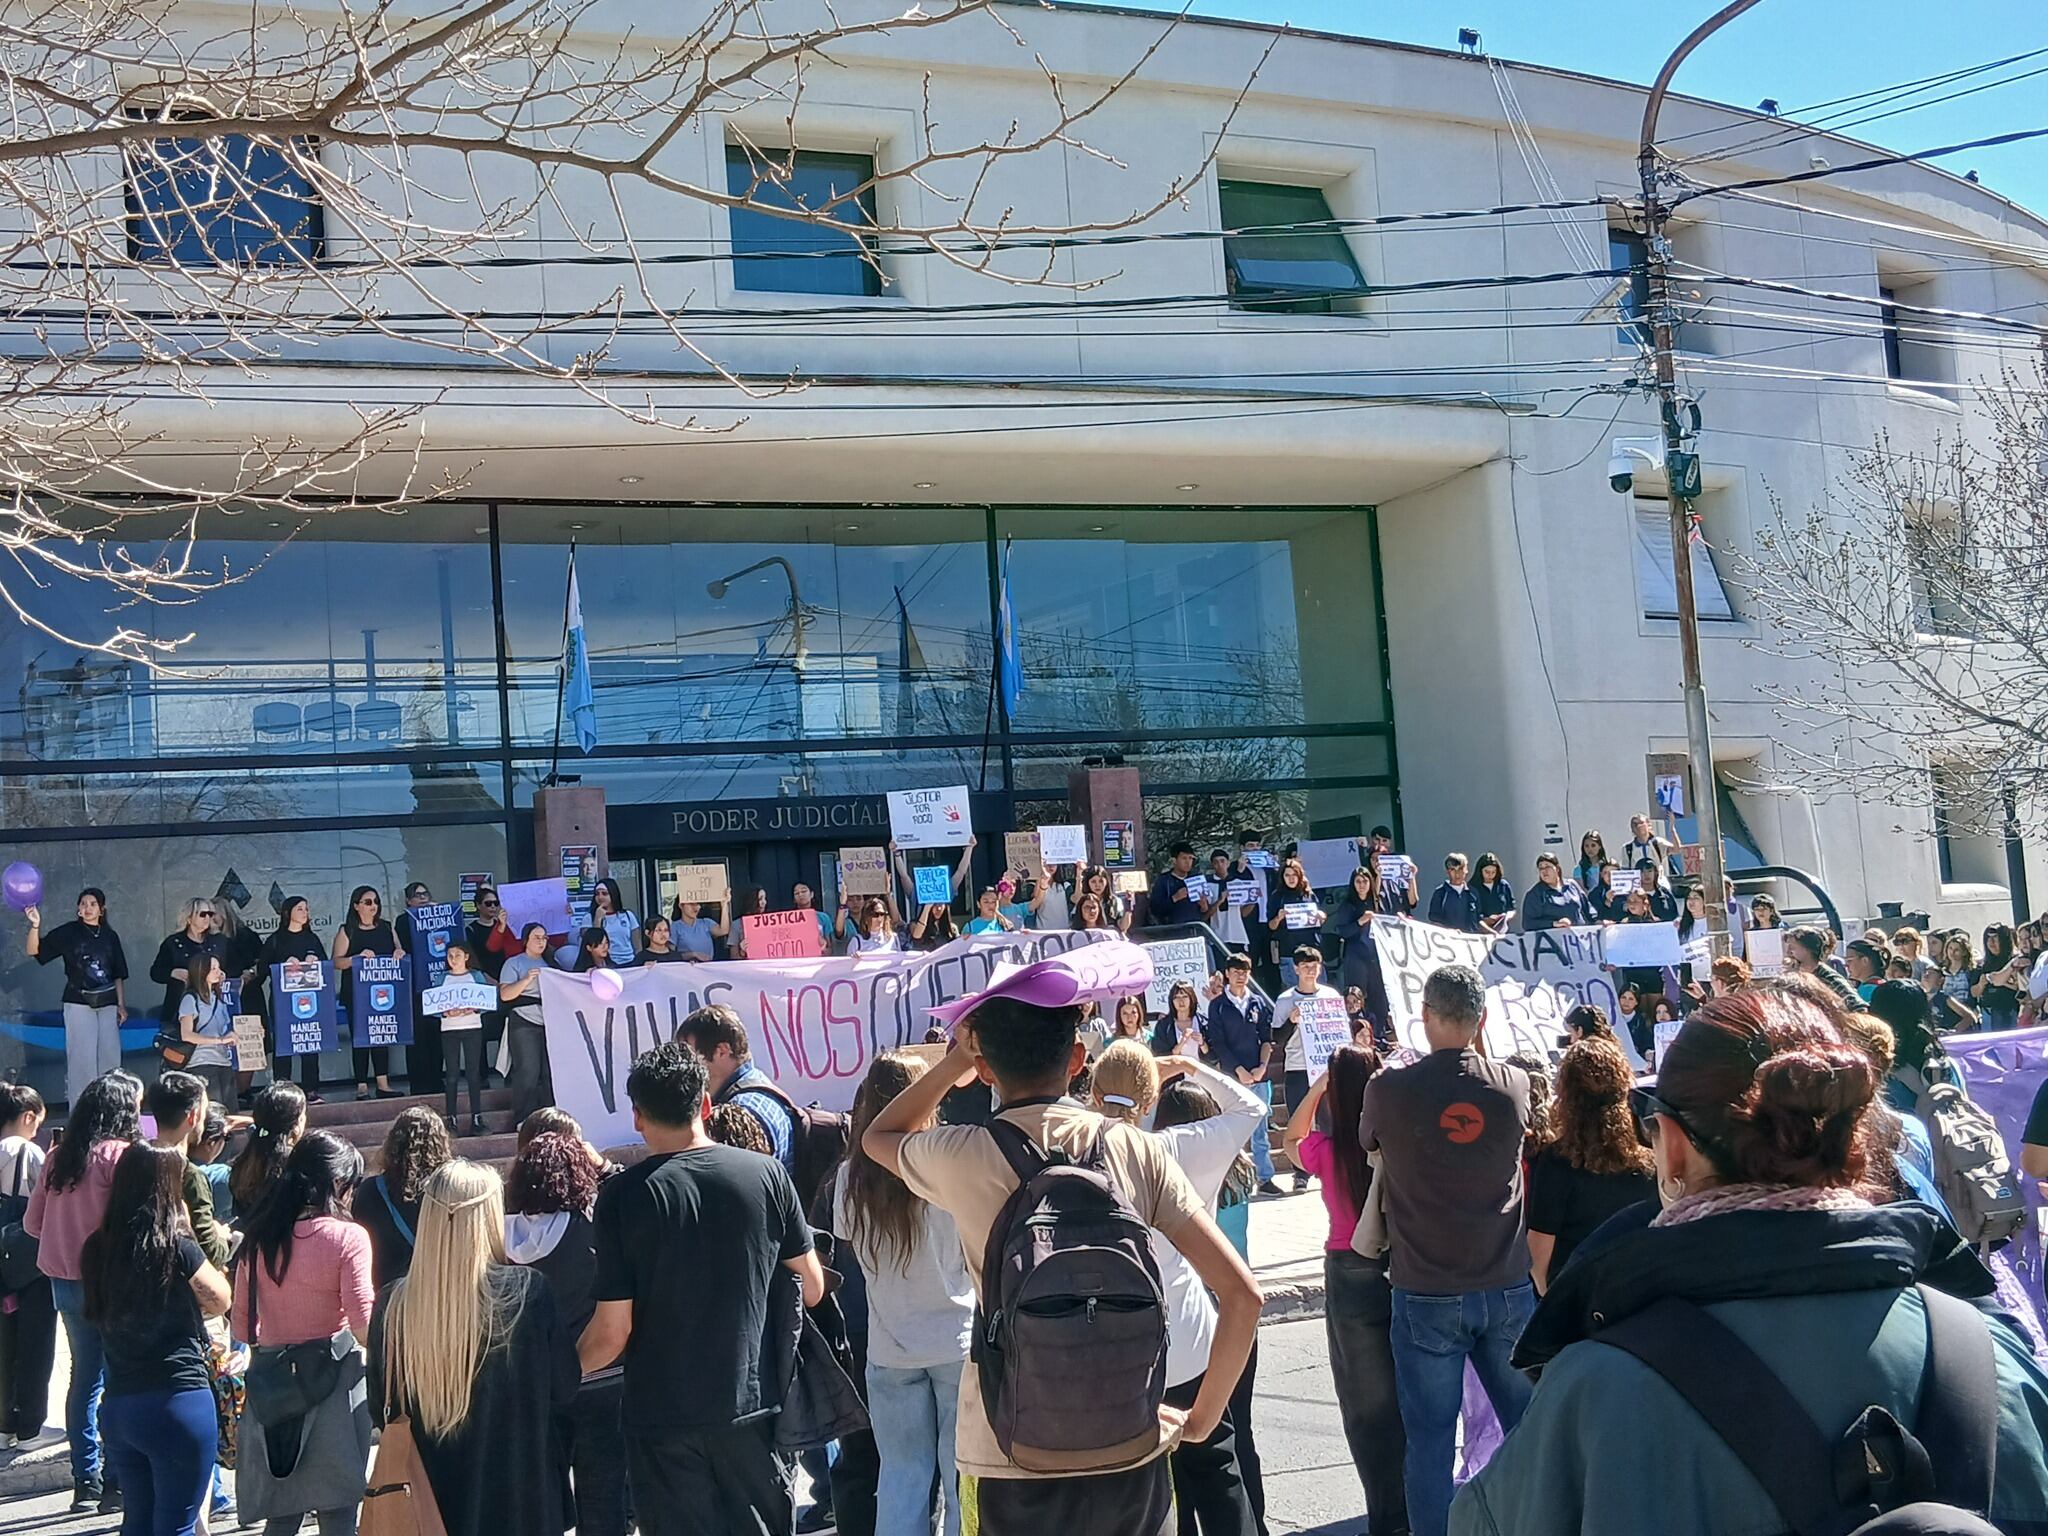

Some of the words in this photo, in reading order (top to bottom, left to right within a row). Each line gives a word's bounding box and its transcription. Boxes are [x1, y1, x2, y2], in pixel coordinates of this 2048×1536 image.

[672, 808, 760, 834] PODER
[418, 904, 452, 919] COLEGIO
[416, 917, 458, 931] NACIONAL
[754, 911, 806, 927] JUSTICIA
[1380, 921, 1568, 971] JUSTICIA
[363, 957, 400, 970] COLEGIO
[428, 961, 445, 973] MAN
[359, 969, 404, 982] NACIONAL
[424, 988, 486, 1007] JUSTICIA
[368, 1015, 398, 1025] MANUEL
[290, 1022, 321, 1033] MANUEL
[368, 1024, 398, 1036] IGNACIO
[759, 979, 865, 1080] NOS
[291, 1031, 321, 1044] IGNACIO
[369, 1035, 398, 1045] MOLINA
[292, 1043, 321, 1054] MOLINA
